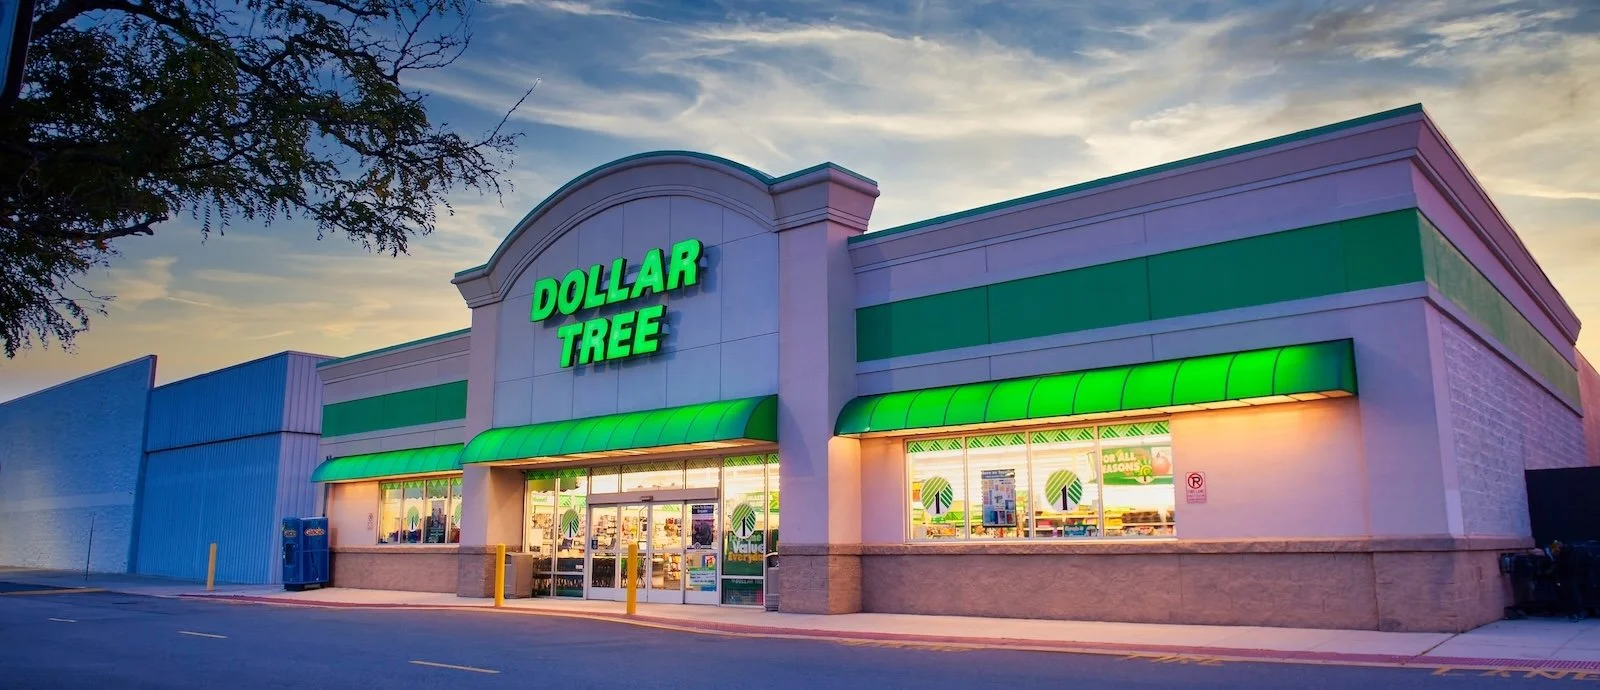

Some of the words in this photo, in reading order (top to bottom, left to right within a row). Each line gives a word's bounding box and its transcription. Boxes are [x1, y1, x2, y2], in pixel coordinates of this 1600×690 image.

[530, 237, 703, 323] DOLLAR
[556, 304, 668, 369] TREE
[1117, 451, 1137, 463] ALL
[1103, 462, 1141, 474] EASONS
[732, 540, 764, 553] Value
